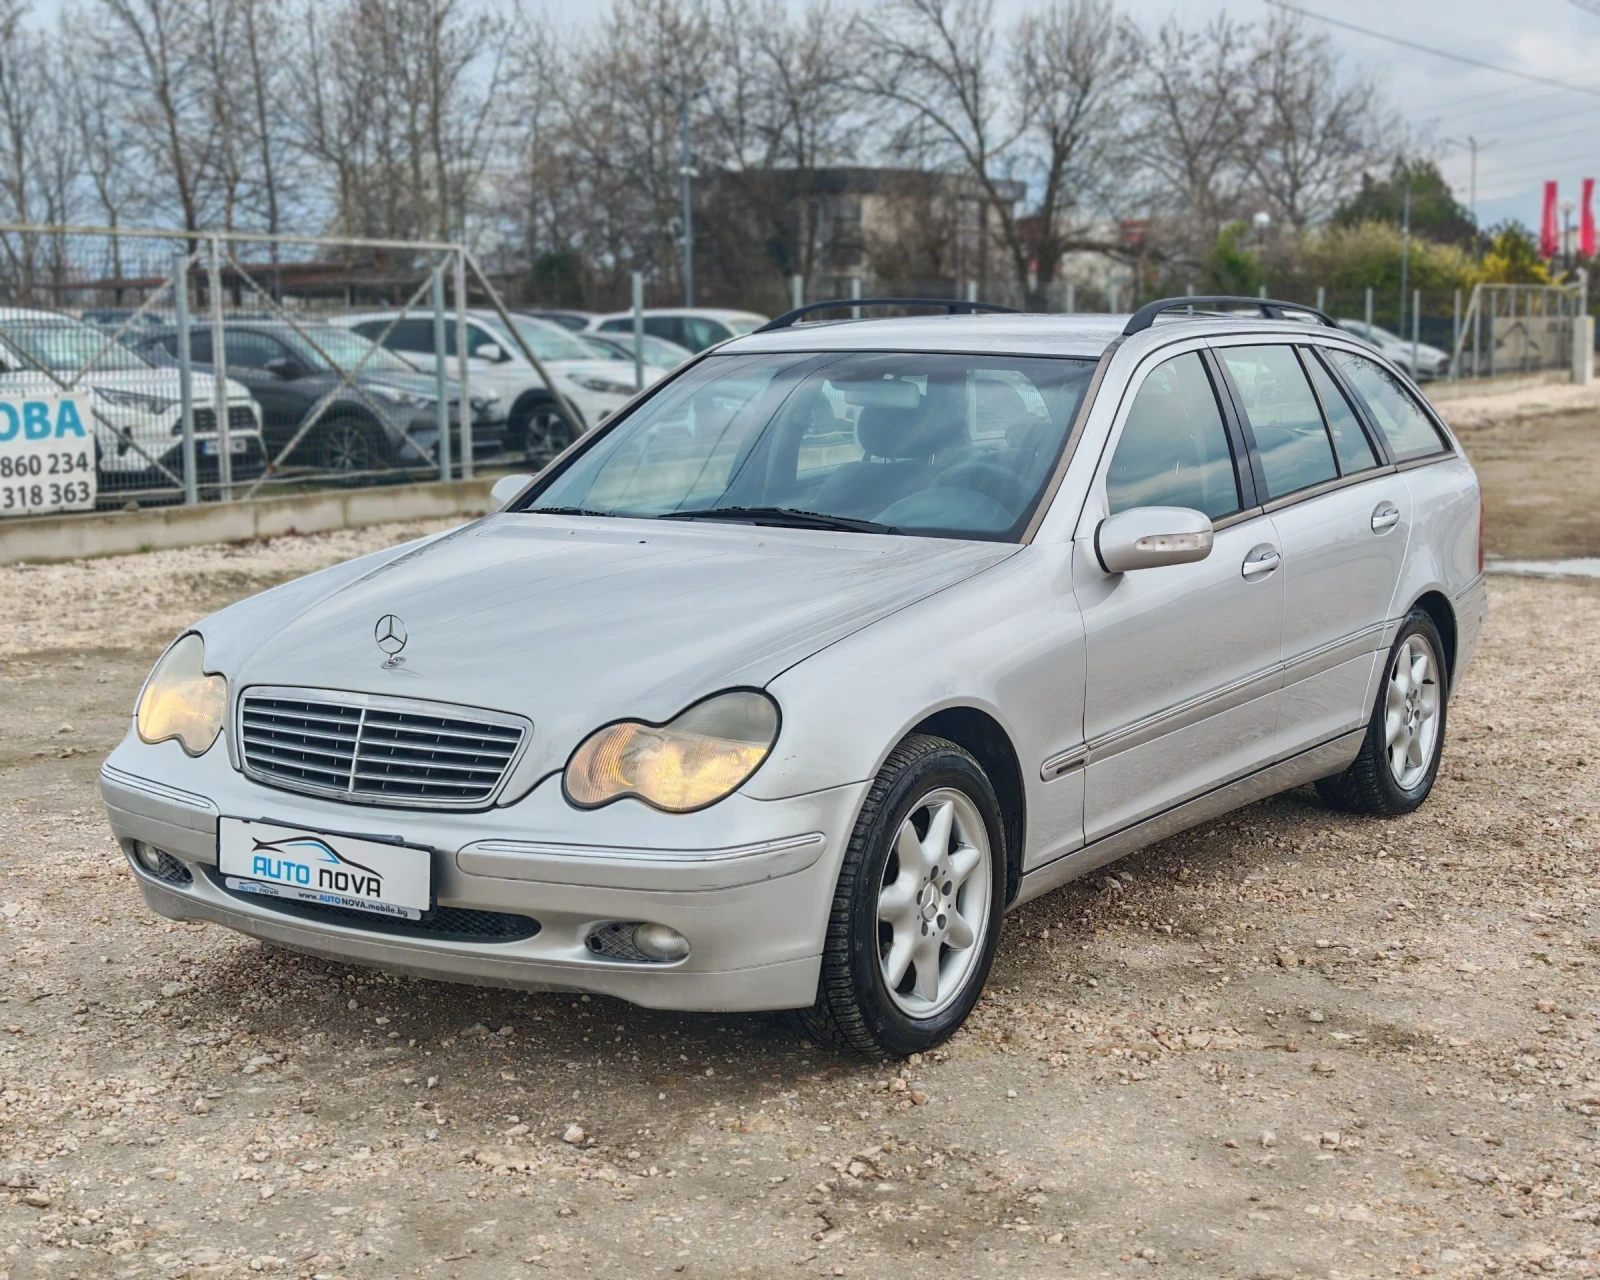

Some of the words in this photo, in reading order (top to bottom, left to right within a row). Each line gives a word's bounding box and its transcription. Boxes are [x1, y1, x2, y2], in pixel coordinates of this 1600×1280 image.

[1, 454, 42, 478] 860
[47, 451, 88, 475] 234
[2, 484, 43, 509] 318
[49, 481, 90, 505] 363
[253, 855, 310, 885] AUTO
[319, 868, 381, 898] NOVA
